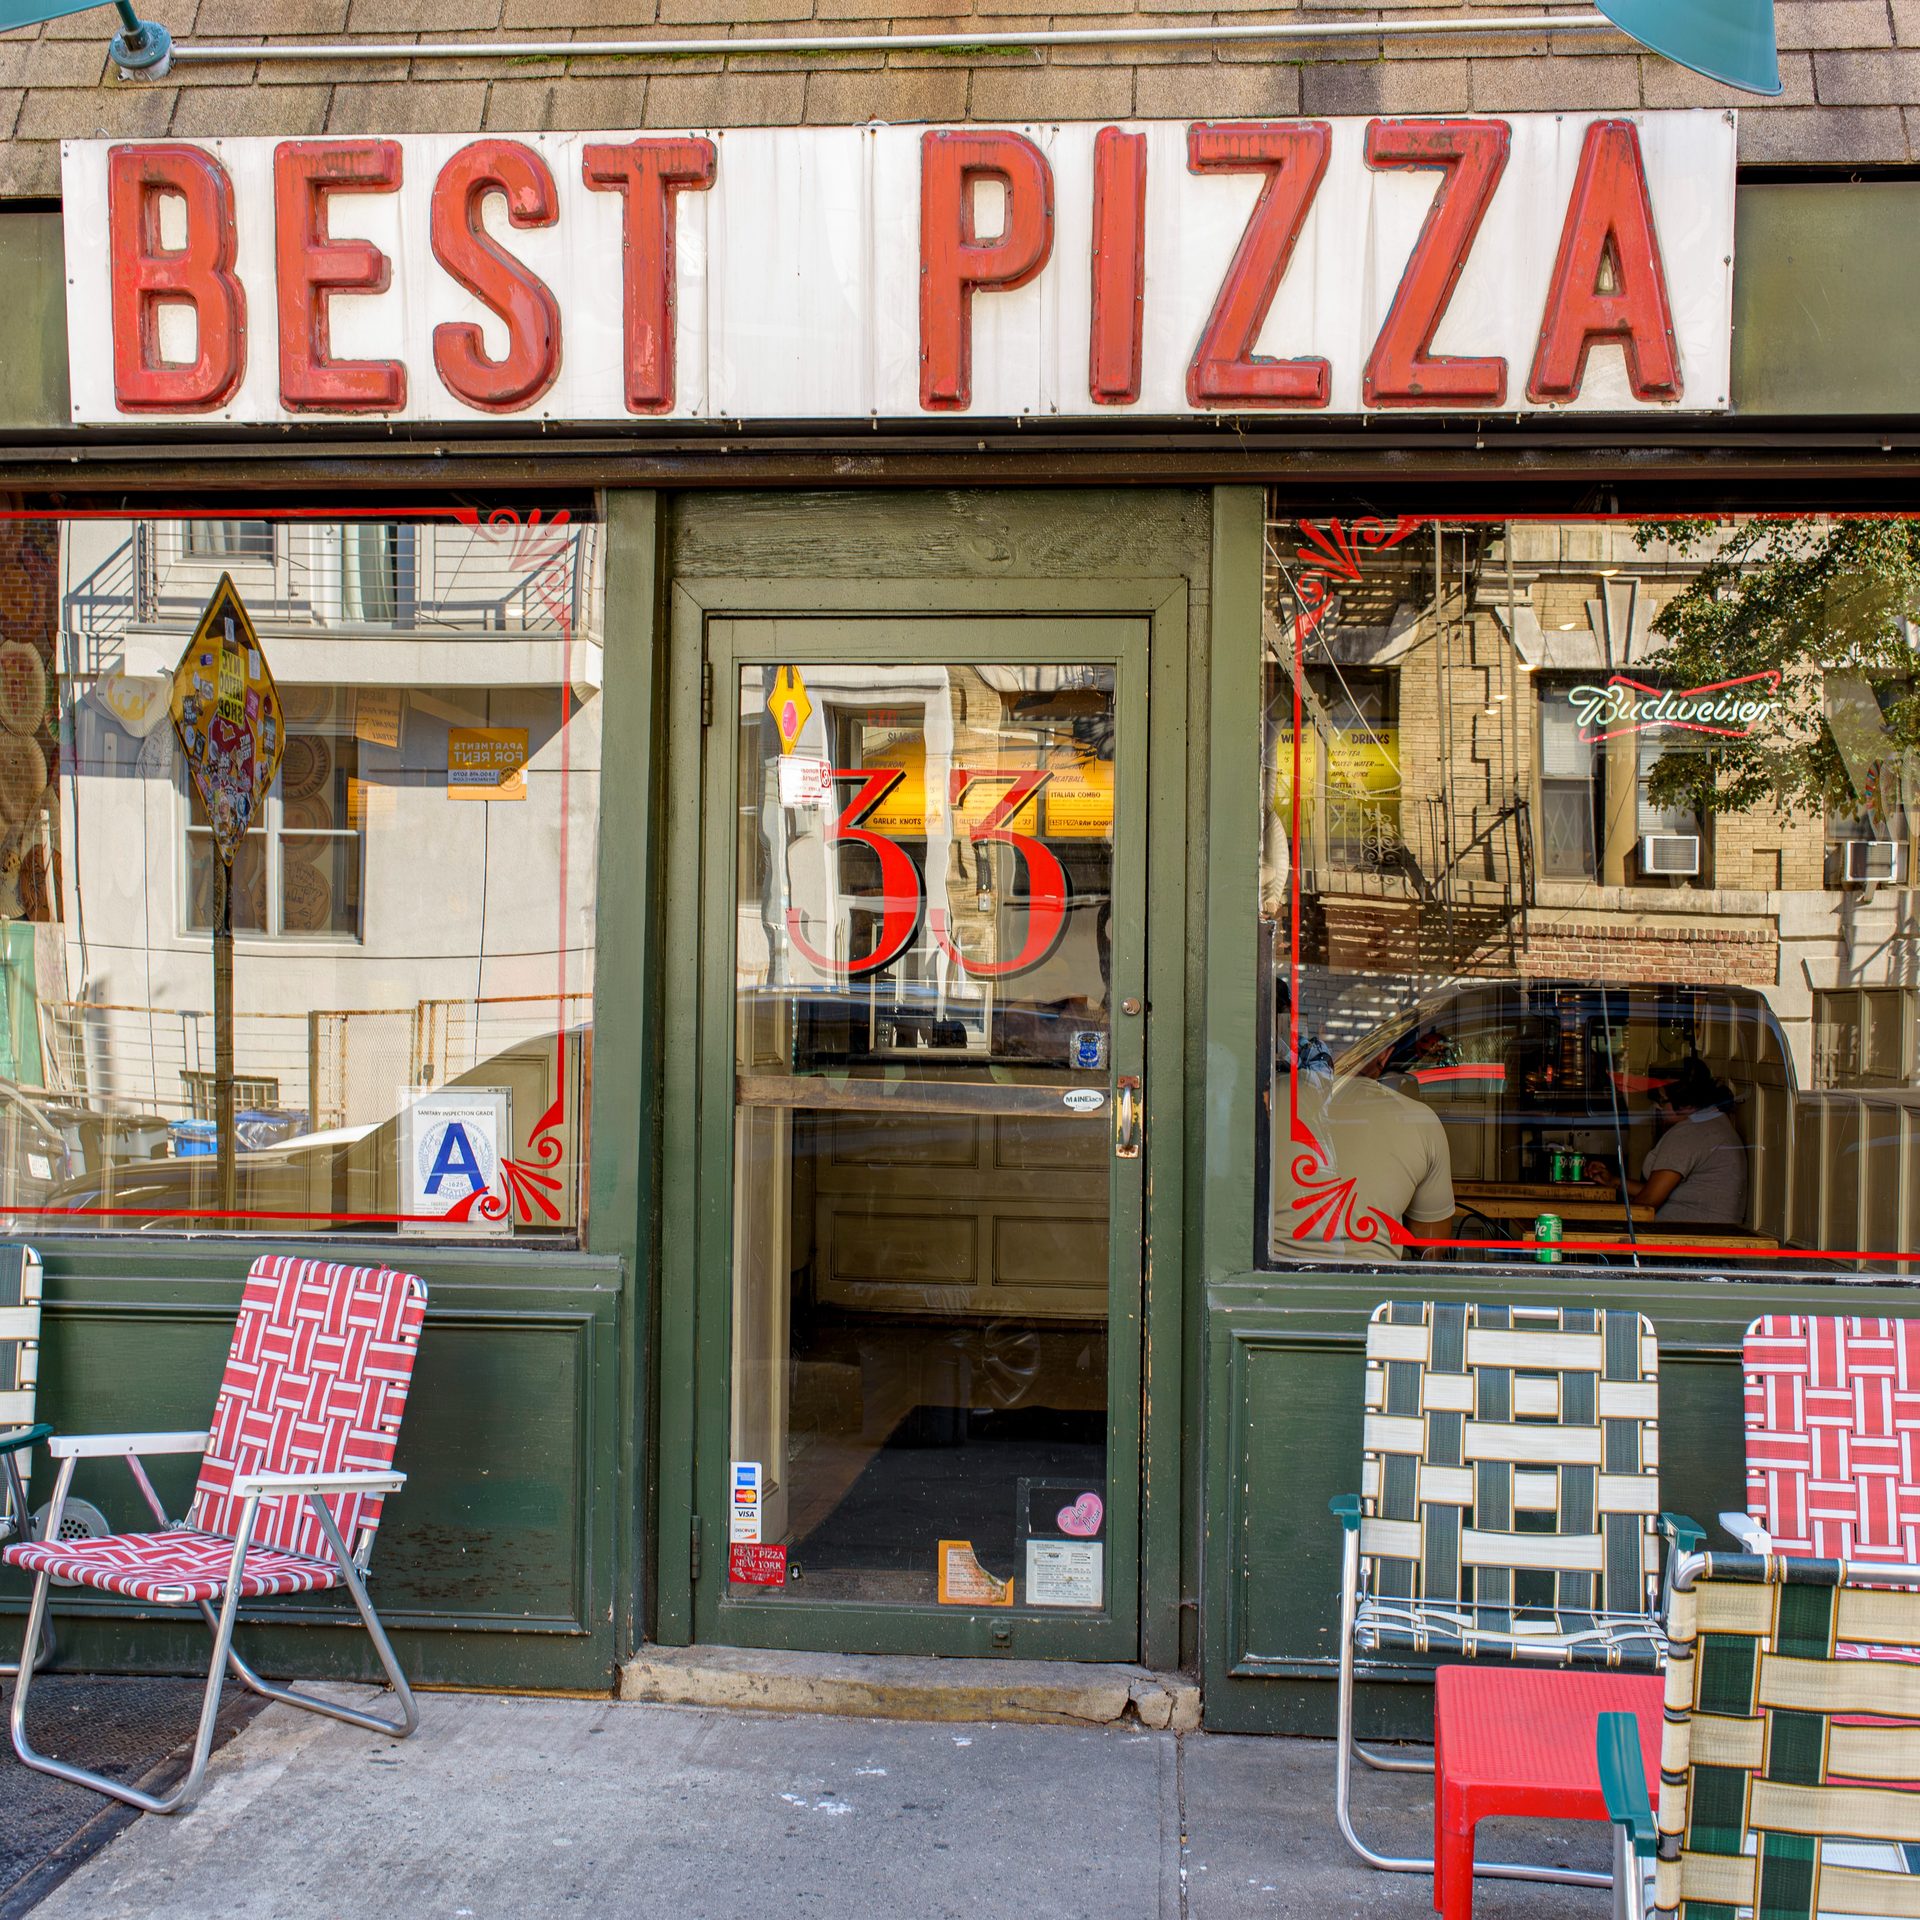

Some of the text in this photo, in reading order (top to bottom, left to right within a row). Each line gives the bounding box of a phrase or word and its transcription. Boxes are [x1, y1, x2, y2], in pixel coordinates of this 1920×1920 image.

[107, 118, 1685, 415] BEST PIZZA
[1568, 685, 1783, 728] Budweiser
[1281, 733, 1390, 744] WIE DRINKS
[873, 817, 897, 825] GARLIC
[899, 818, 922, 826] KNOTS
[786, 768, 1074, 980] 33
[423, 1123, 489, 1194] A
[734, 1548, 785, 1560] REAL PIZZA
[735, 1559, 782, 1570] NEW YORK
